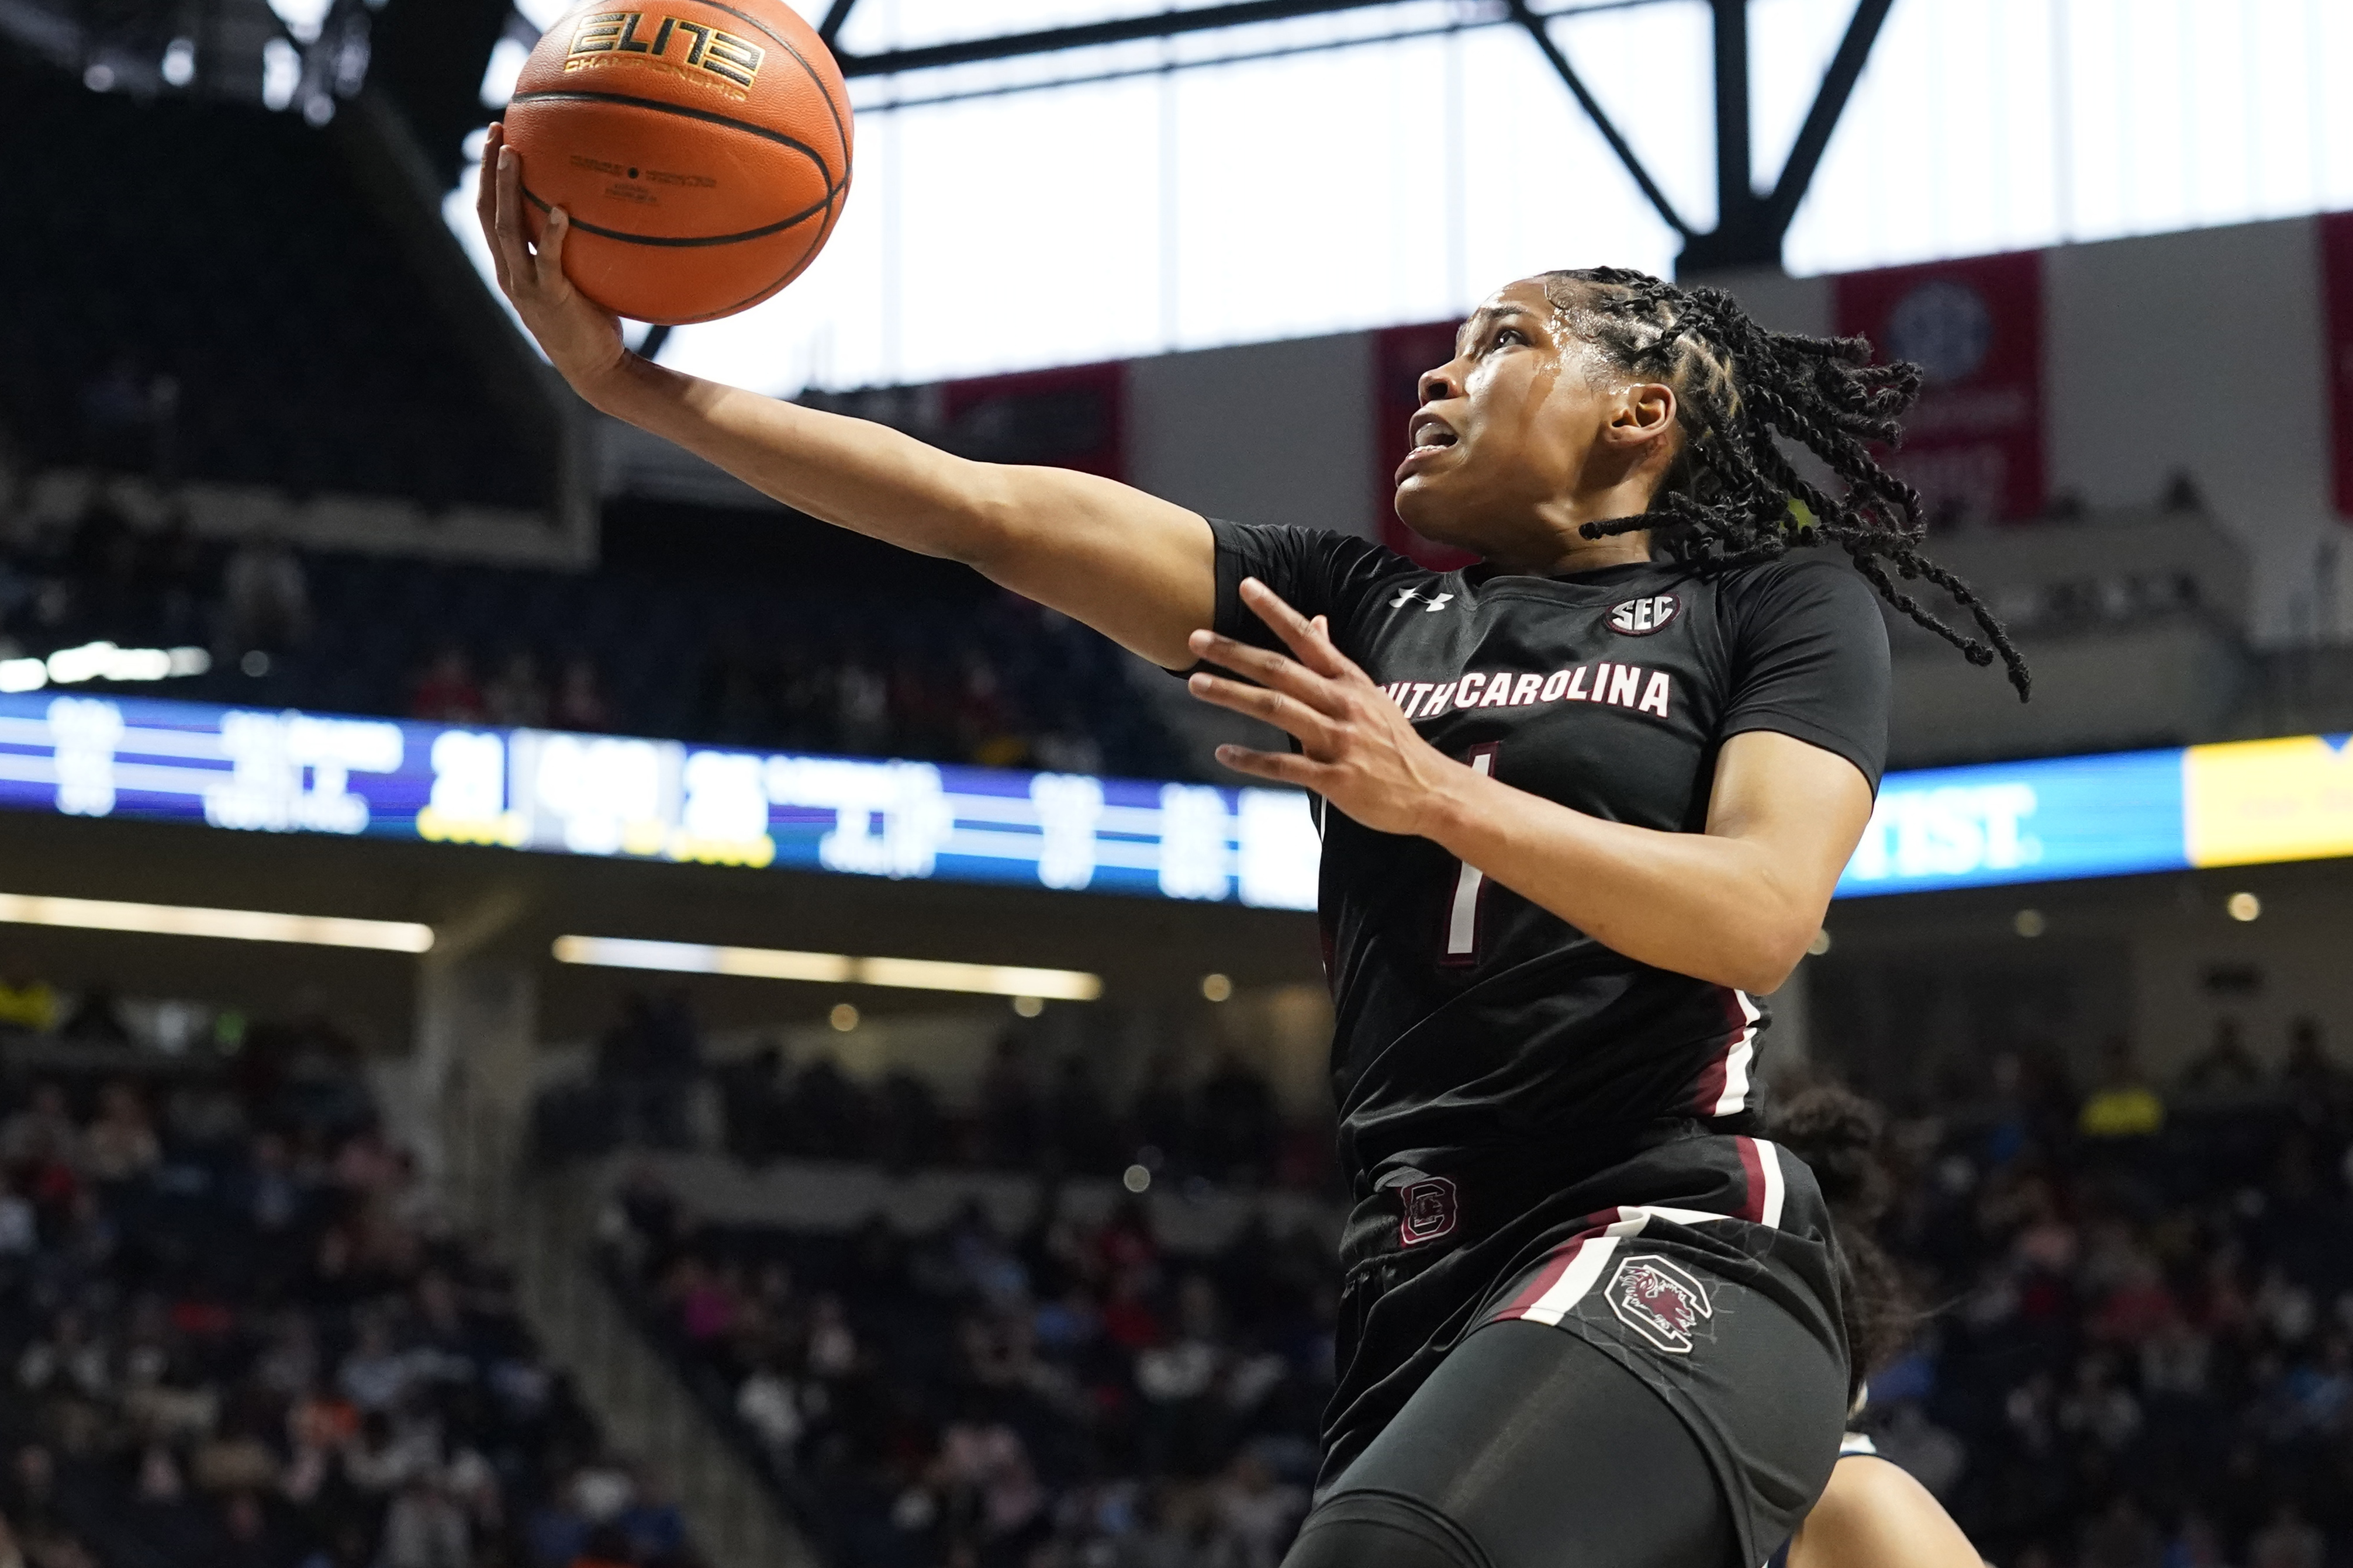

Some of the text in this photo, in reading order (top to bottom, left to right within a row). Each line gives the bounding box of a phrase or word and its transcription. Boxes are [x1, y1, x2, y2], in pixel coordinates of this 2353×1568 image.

[568, 12, 766, 90] ELITE
[1612, 596, 1673, 630] SEC
[1454, 663, 1670, 718] CAROLINA
[1443, 747, 1495, 960] 1
